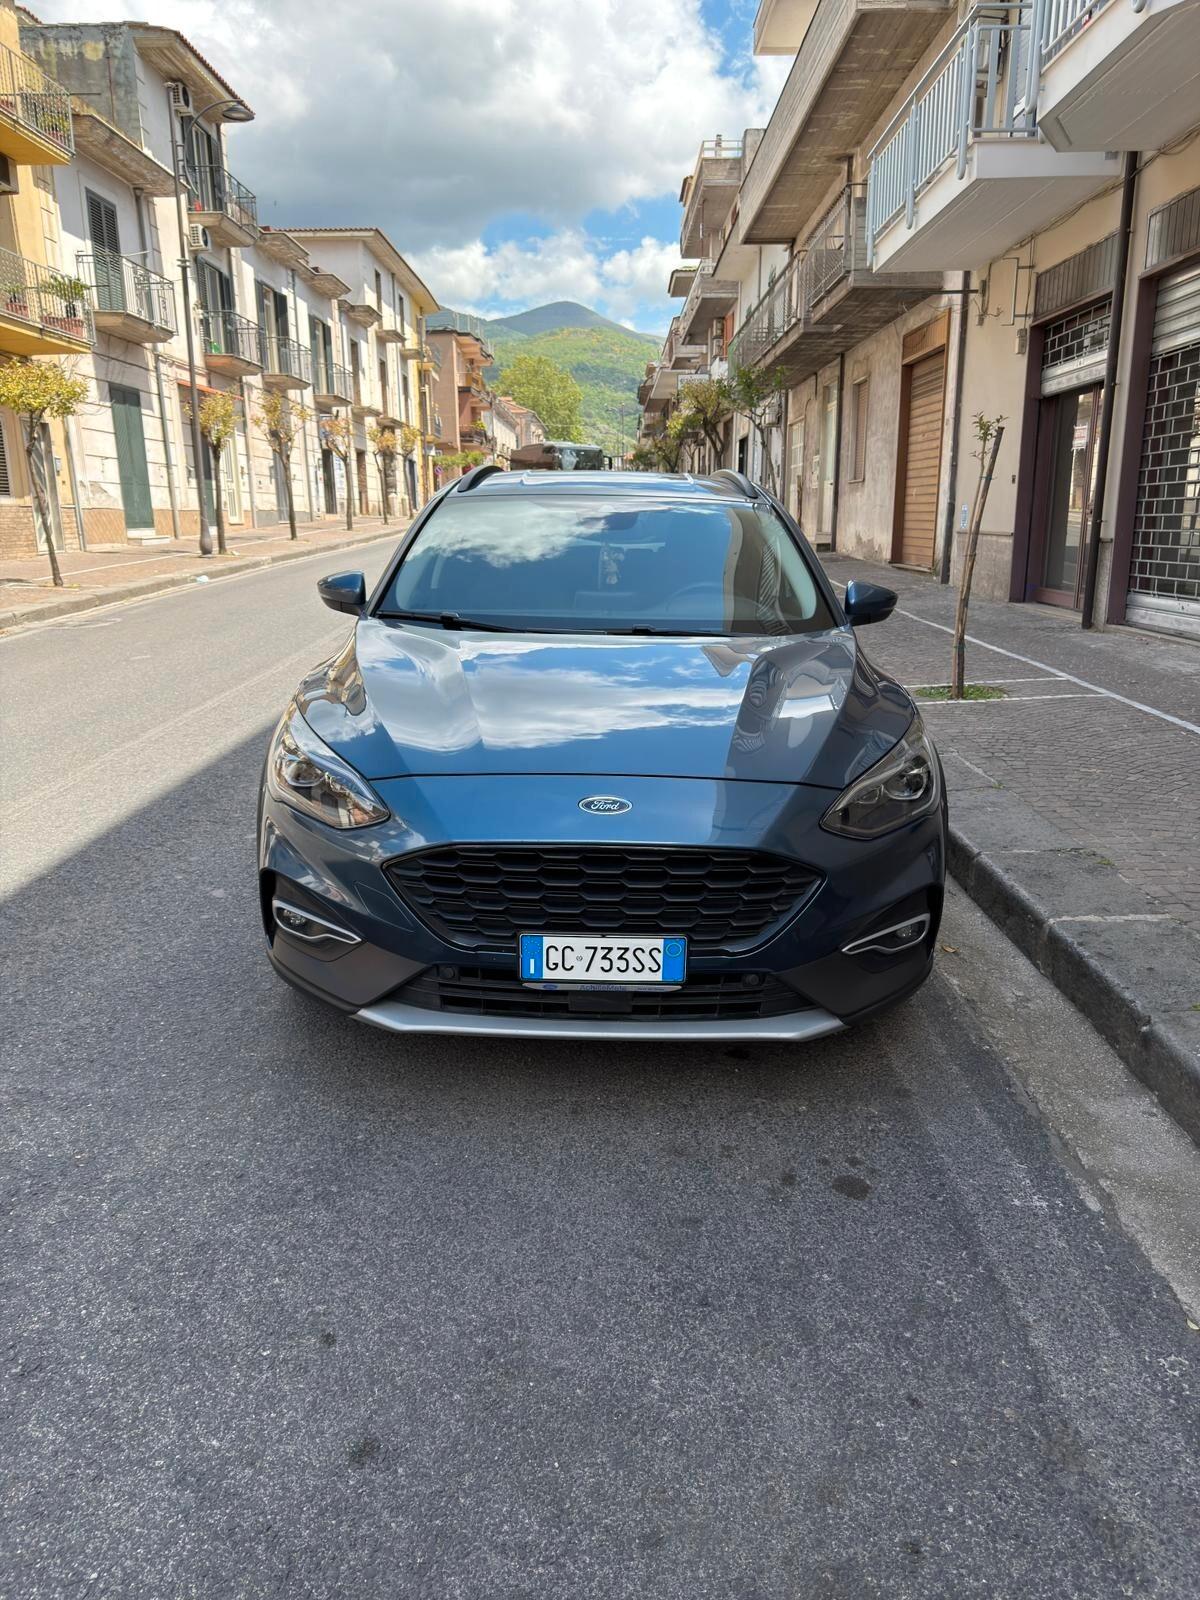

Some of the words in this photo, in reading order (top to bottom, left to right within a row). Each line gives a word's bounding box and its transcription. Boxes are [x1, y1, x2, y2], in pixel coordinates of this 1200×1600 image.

[590, 799, 620, 810] Ford
[545, 945, 575, 972] GC
[584, 946, 662, 973] 733SS
